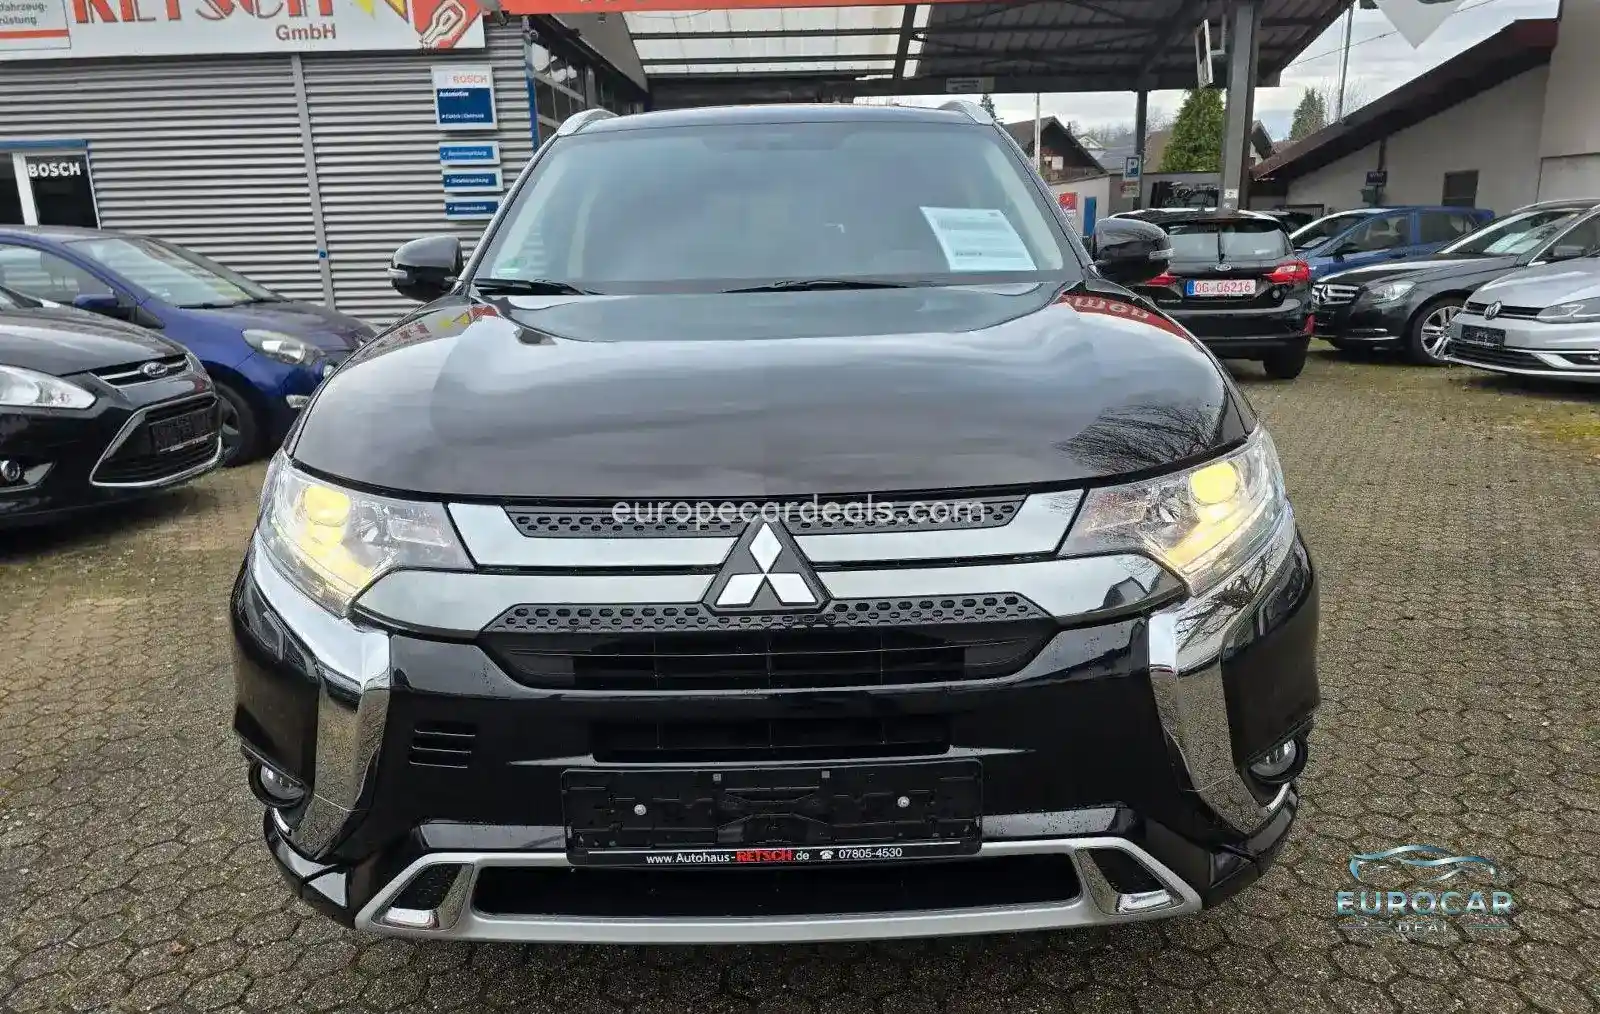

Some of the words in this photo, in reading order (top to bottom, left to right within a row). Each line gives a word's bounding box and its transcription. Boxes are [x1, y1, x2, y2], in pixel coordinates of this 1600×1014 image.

[275, 23, 337, 41] GmbH
[27, 162, 81, 177] BOSCH
[838, 847, 903, 859] 07805-4530
